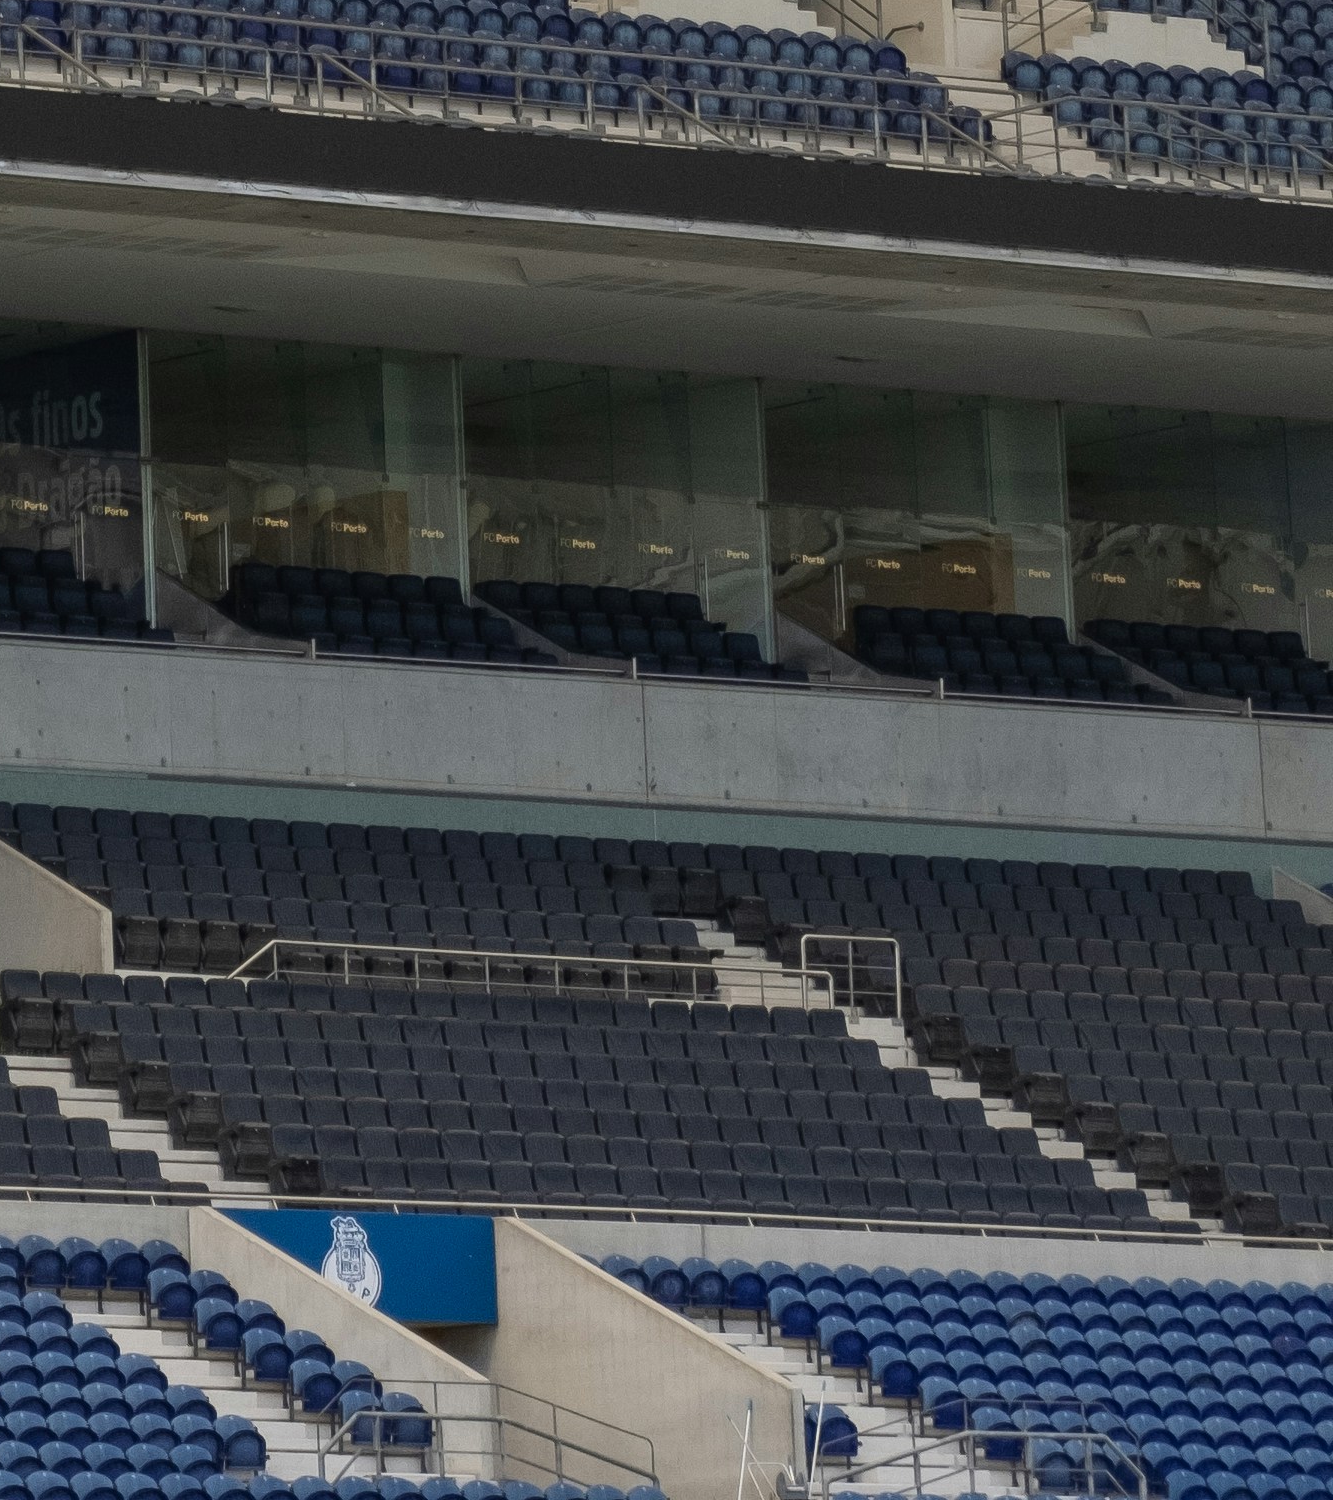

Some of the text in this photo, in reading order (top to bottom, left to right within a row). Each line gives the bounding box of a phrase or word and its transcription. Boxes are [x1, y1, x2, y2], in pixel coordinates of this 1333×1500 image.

[265, 518, 288, 528] Porto
[496, 534, 519, 544] Porto
[878, 560, 900, 569] Porto
[1103, 574, 1125, 584] Porto
